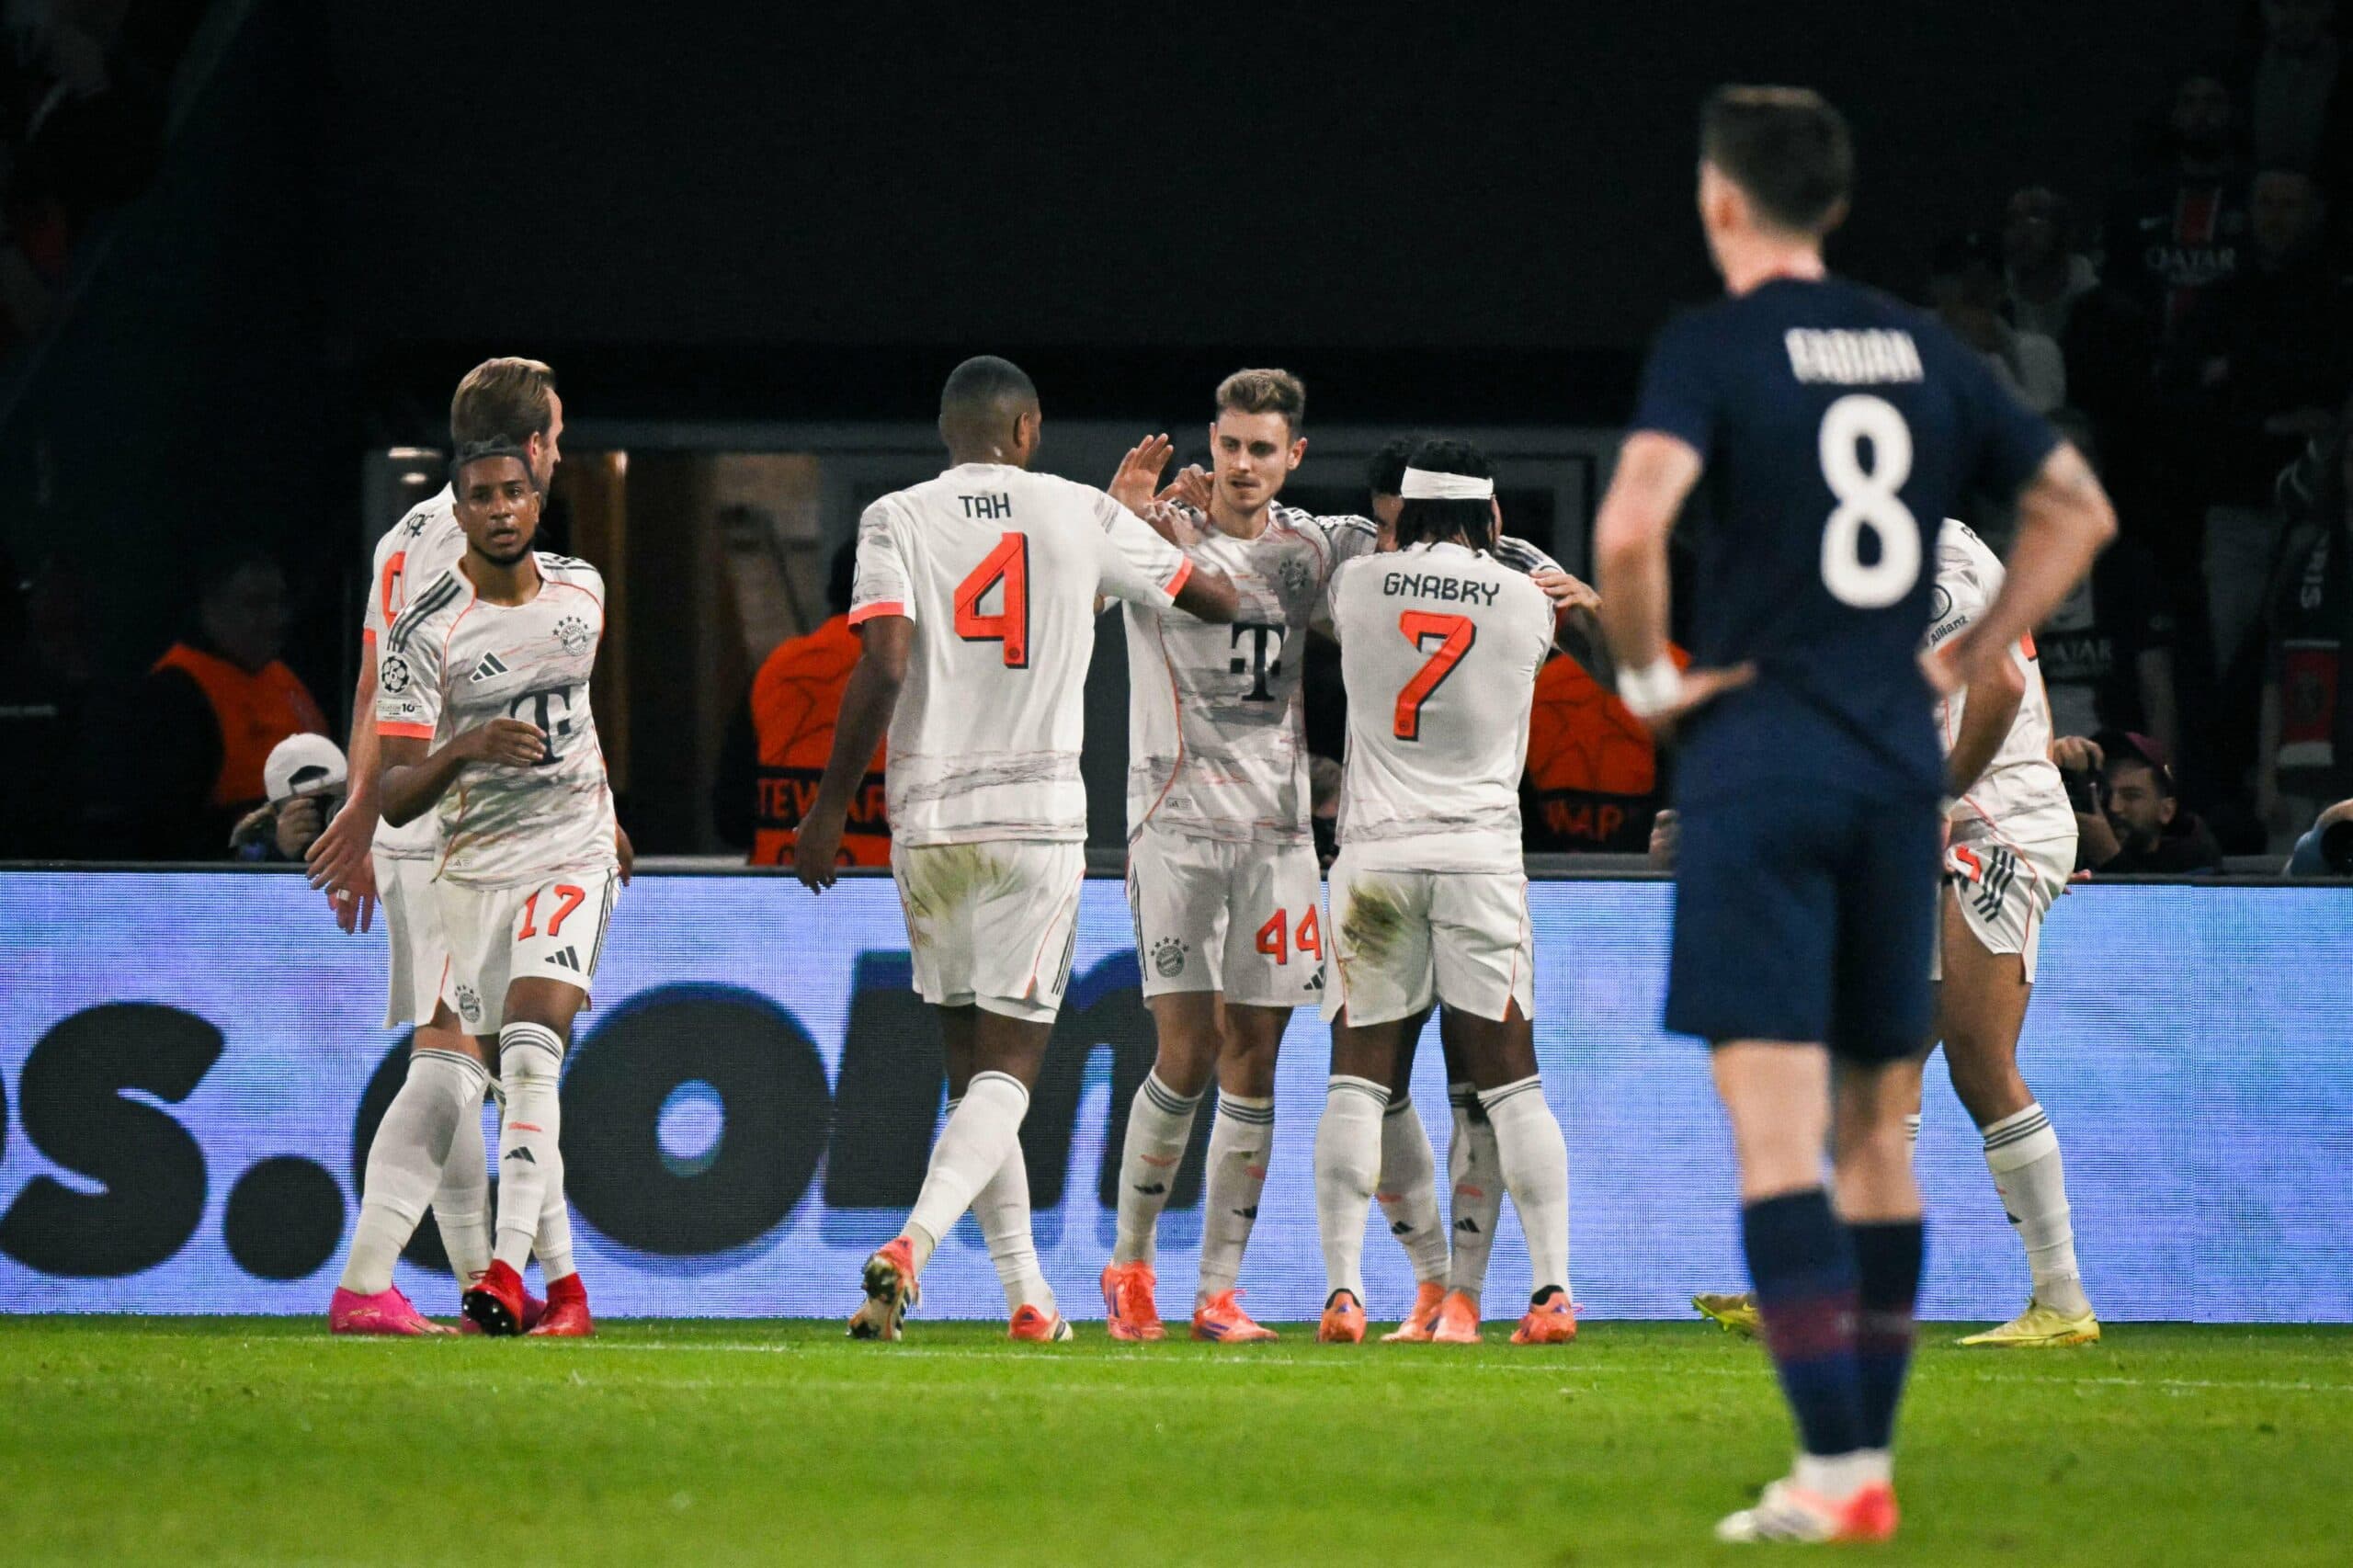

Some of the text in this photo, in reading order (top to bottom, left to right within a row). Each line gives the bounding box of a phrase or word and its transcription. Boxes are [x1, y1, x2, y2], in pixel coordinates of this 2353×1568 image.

[959, 493, 1012, 519] TAH
[1819, 392, 1923, 608] 8
[954, 531, 1029, 669] 4
[1383, 572, 1500, 607] GNABRY
[1930, 615, 1969, 647] Allianz
[1393, 608, 1477, 742] 7
[517, 883, 585, 941] 17
[1256, 903, 1324, 965] 44
